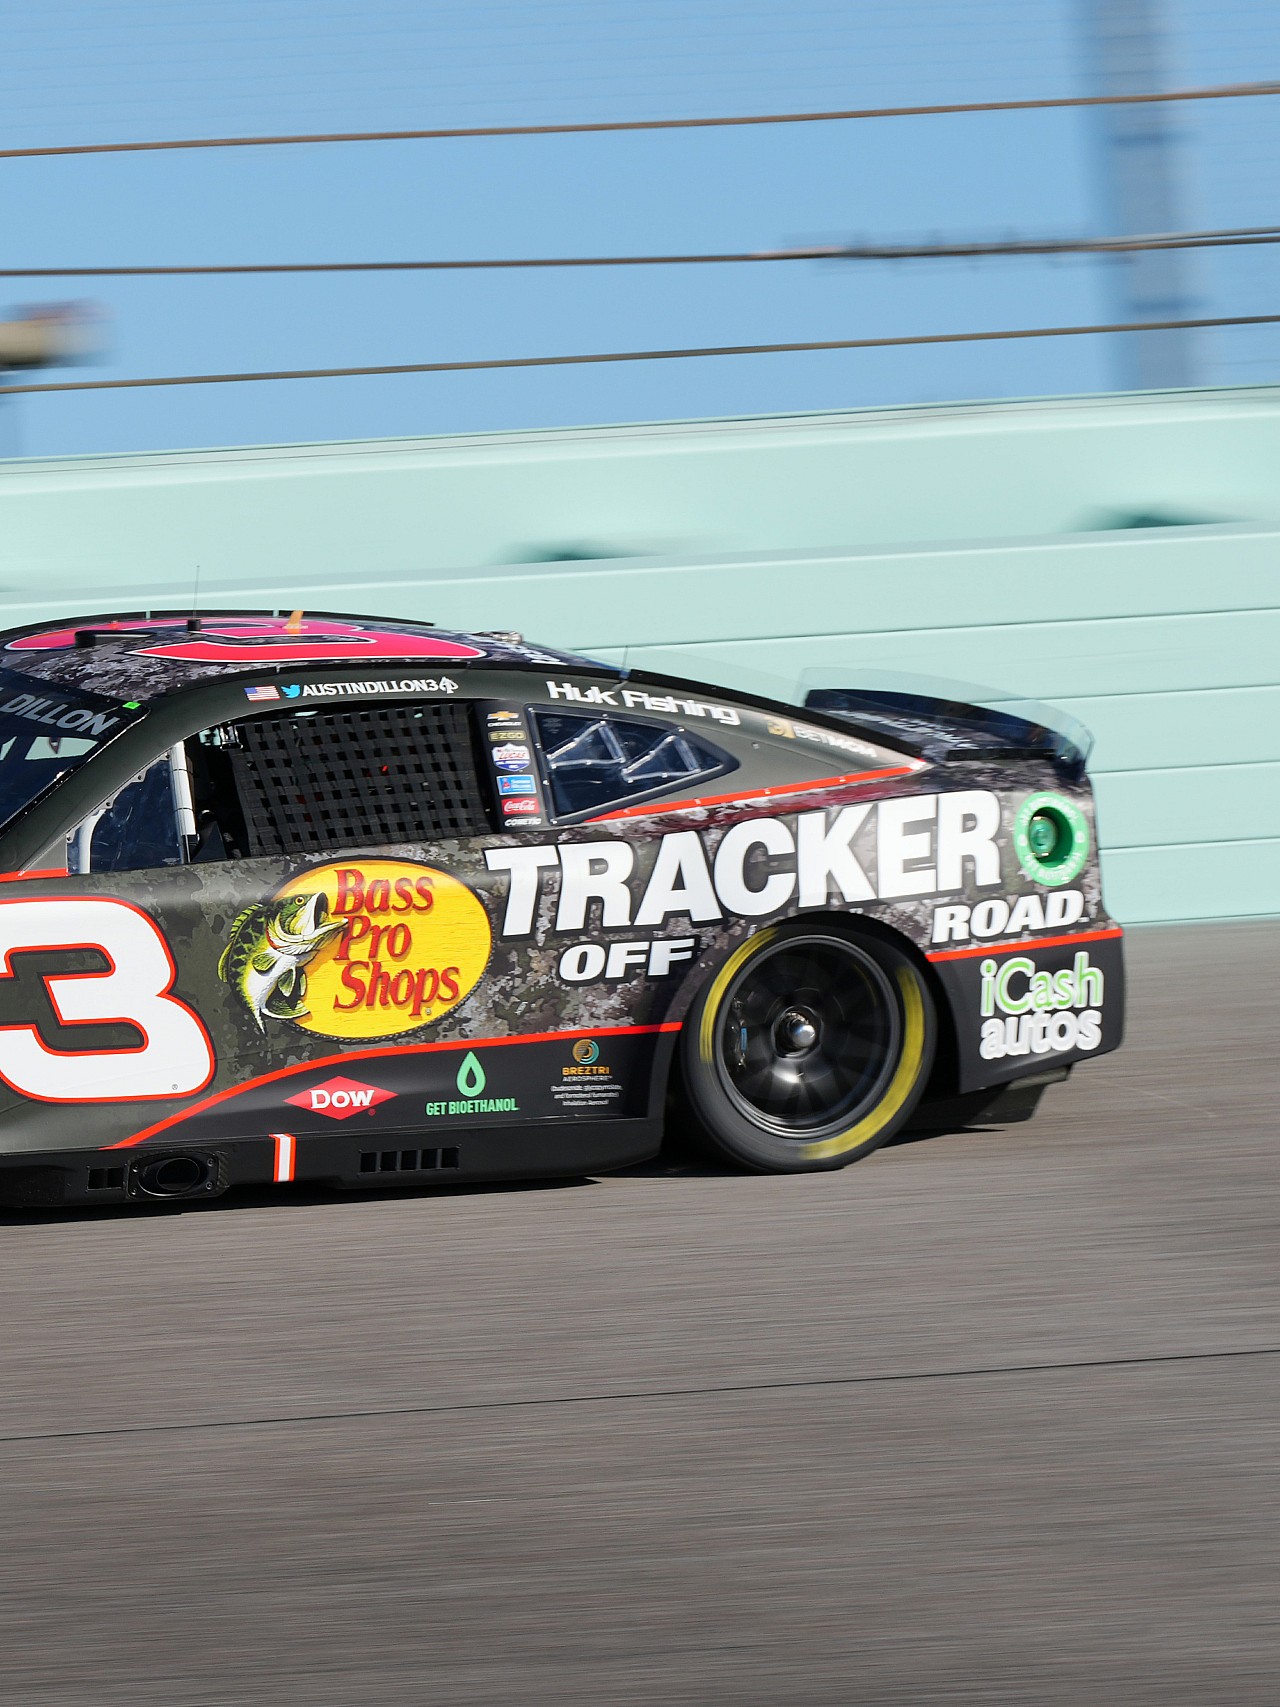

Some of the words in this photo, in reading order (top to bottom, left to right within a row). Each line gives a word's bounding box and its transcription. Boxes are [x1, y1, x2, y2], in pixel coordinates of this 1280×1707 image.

[546, 681, 619, 706] Huk
[621, 690, 740, 726] Fishing
[484, 790, 1001, 936] TRACKER
[331, 869, 436, 915] Bass
[333, 915, 412, 961] Pro
[559, 939, 693, 981] OFF
[932, 890, 1084, 943] ROAD
[333, 960, 460, 1017] Shops
[980, 951, 1104, 1016] iCash
[980, 1010, 1102, 1059] autos
[562, 1066, 610, 1076] BREZTRI
[426, 1102, 447, 1116] GET
[448, 1098, 518, 1114] BIOETHANOL
